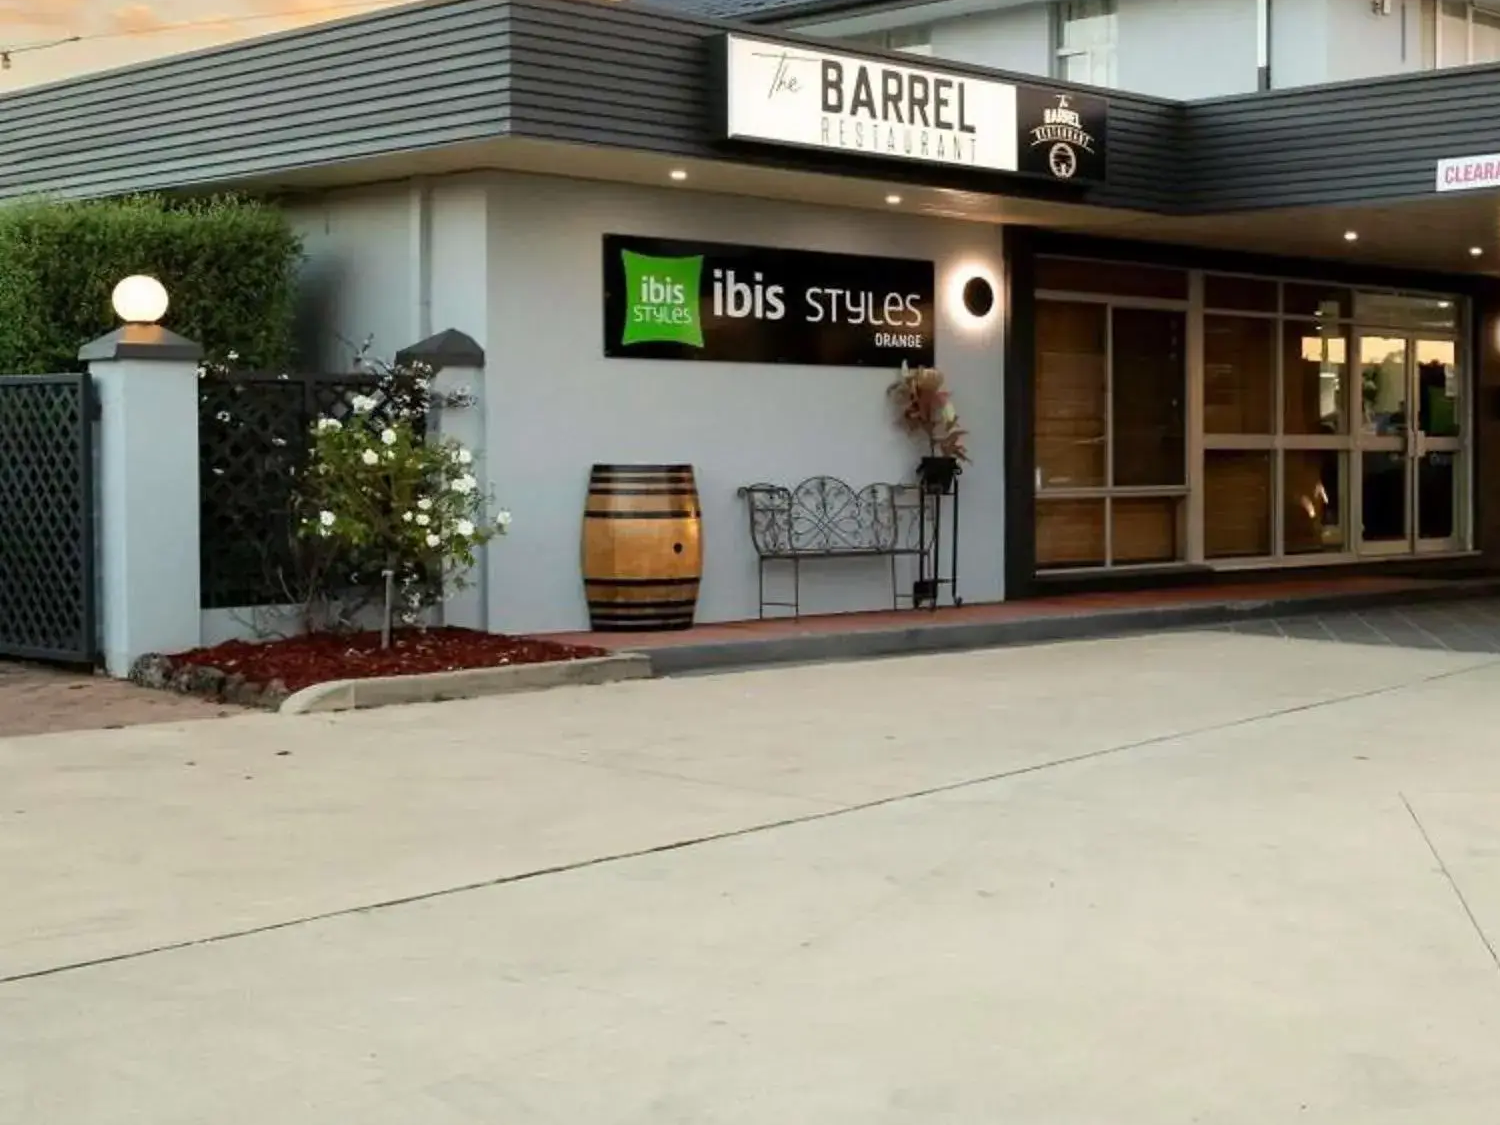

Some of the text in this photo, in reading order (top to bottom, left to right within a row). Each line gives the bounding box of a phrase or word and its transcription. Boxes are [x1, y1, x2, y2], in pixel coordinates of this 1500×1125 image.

[752, 52, 976, 134] The BARREL
[821, 117, 977, 163] RESTAURANT
[641, 276, 684, 304] ibis
[713, 269, 785, 320] ibis
[875, 332, 922, 348] ORANGE
